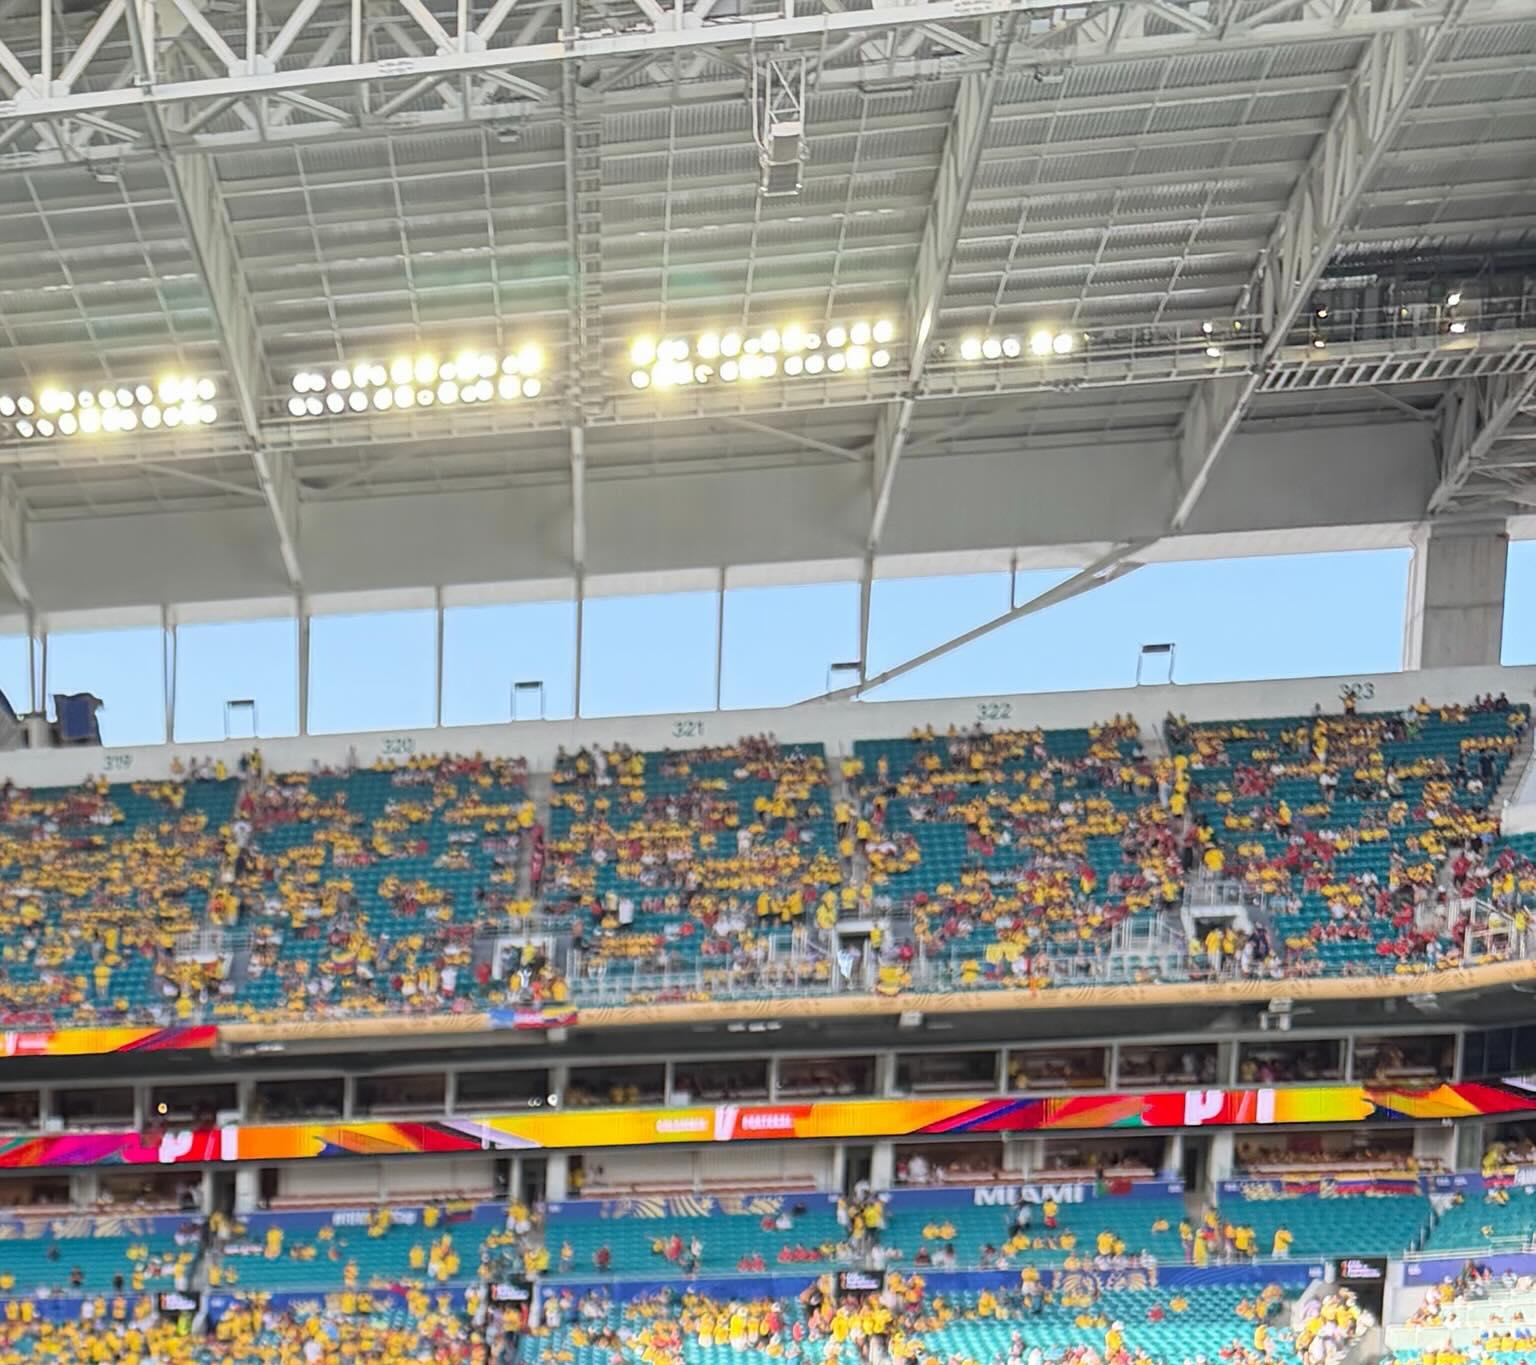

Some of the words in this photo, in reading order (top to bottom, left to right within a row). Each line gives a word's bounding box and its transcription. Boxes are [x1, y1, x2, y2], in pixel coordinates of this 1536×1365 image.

[977, 702, 1013, 720] 322
[671, 719, 705, 738] 321
[973, 1185, 1084, 1206] MIAMI
